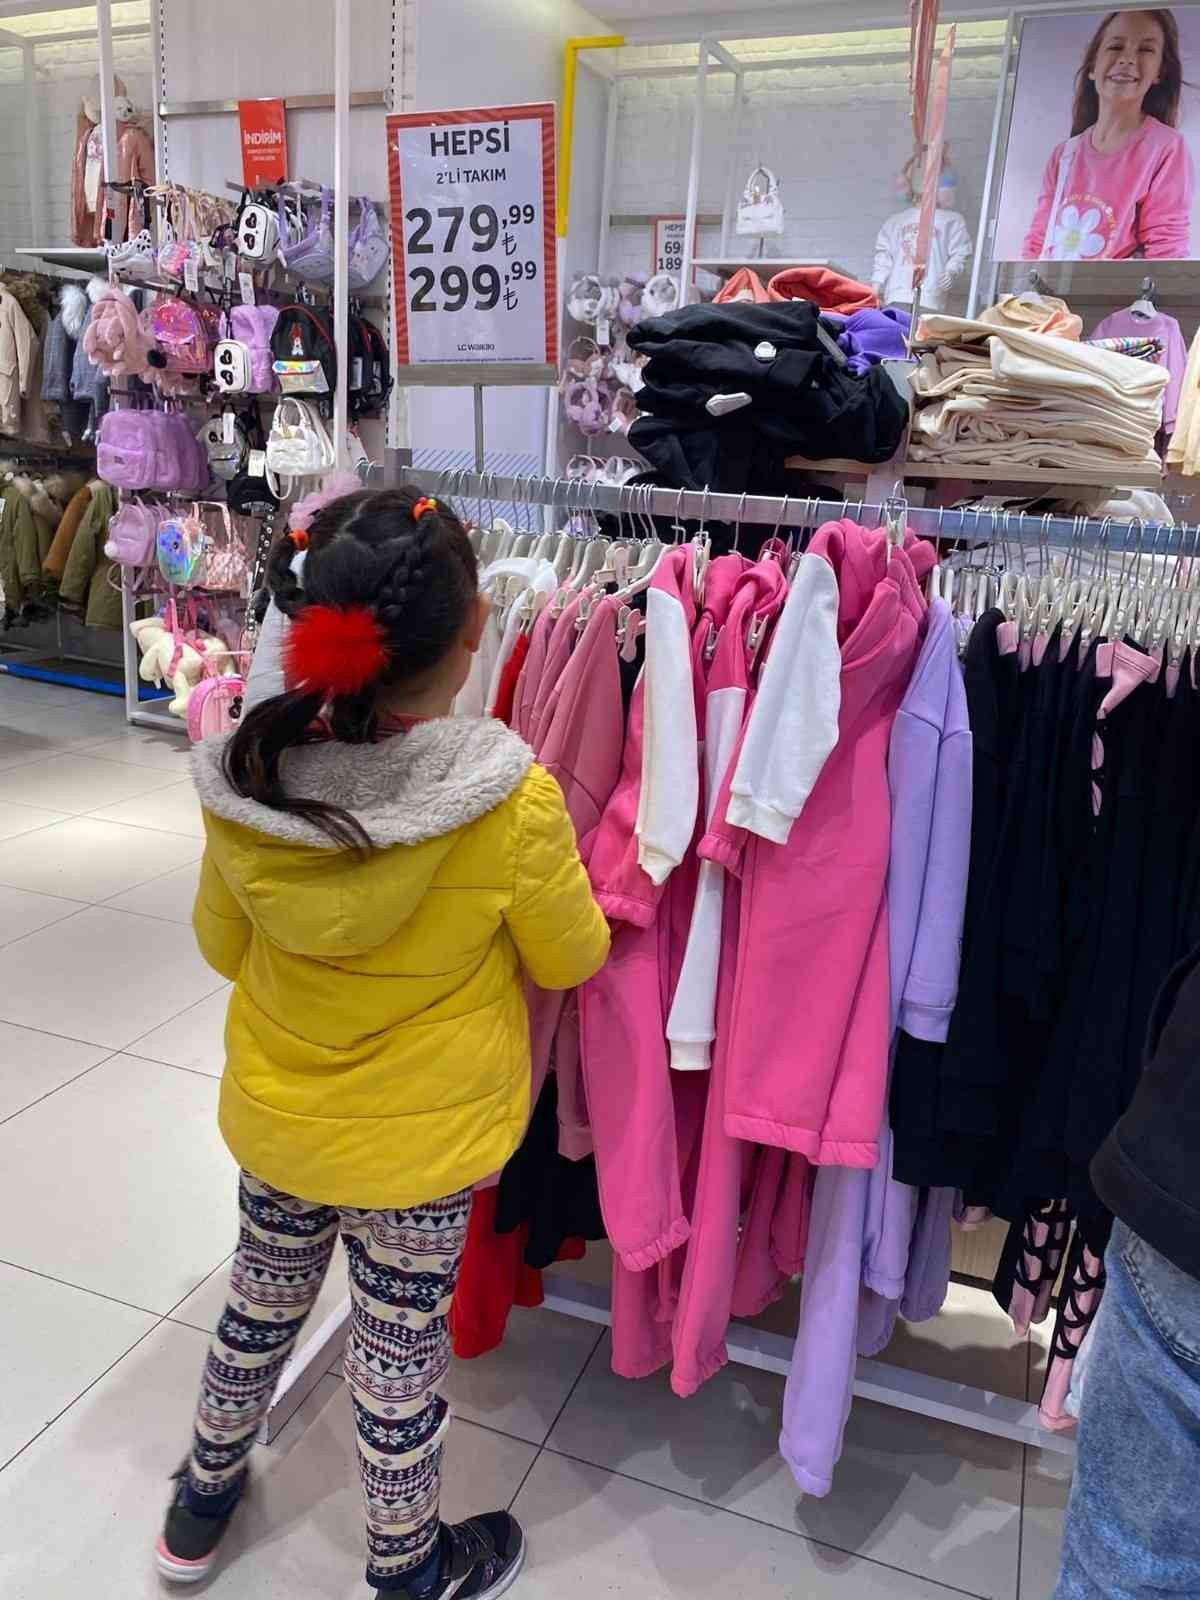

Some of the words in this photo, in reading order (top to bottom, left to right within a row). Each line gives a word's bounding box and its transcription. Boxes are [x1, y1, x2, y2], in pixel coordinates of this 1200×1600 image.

[244, 128, 282, 145] İNDİRİM
[430, 121, 510, 157] HEPSİ
[436, 168, 461, 185] 2'Lİ
[463, 168, 507, 184] TAKIM
